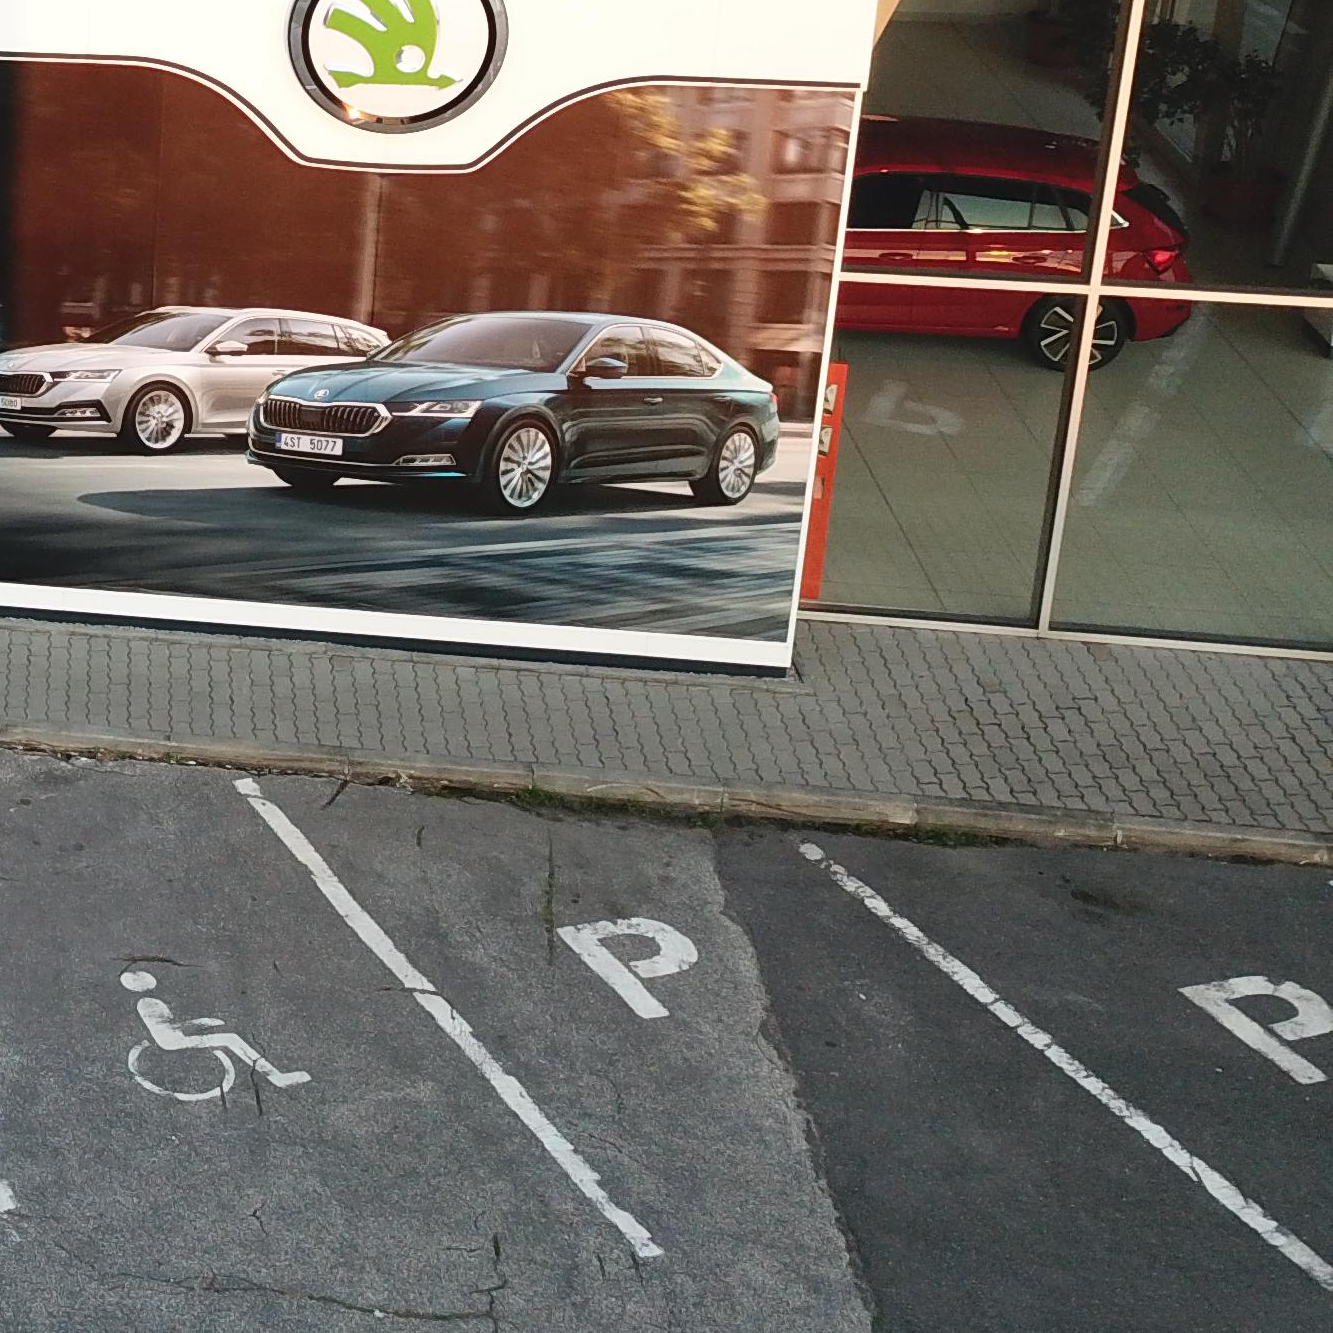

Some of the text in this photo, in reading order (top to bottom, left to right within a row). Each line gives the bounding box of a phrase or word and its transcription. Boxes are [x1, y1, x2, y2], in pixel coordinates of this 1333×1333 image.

[284, 435, 338, 452] 4ST 5077
[557, 917, 699, 1019] P
[1178, 975, 1333, 1085] P
